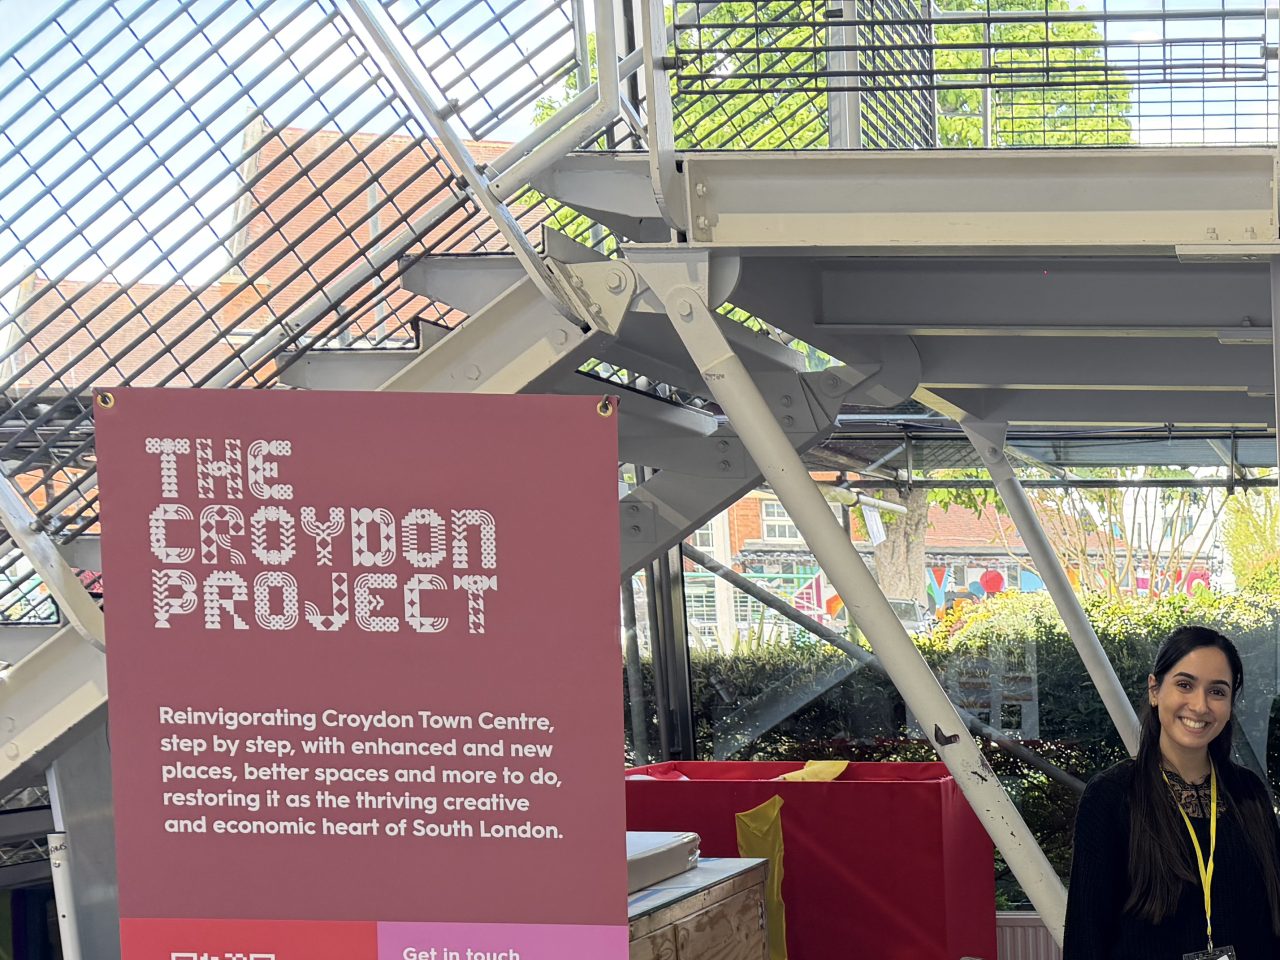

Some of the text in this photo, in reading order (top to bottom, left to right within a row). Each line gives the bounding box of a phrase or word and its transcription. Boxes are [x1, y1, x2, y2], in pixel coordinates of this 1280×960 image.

[145, 438, 293, 499] THE
[149, 504, 496, 569] CROYDON
[152, 569, 497, 633] PROJECT
[160, 707, 554, 733] Reinvigorating Croydon Town Centre,
[161, 734, 553, 757] step by step, with enhanced and new
[162, 762, 561, 787] places, better spaces and more to do,
[164, 789, 529, 814] restoring it as the thriving creative
[165, 816, 563, 838] and economic heart of South London.
